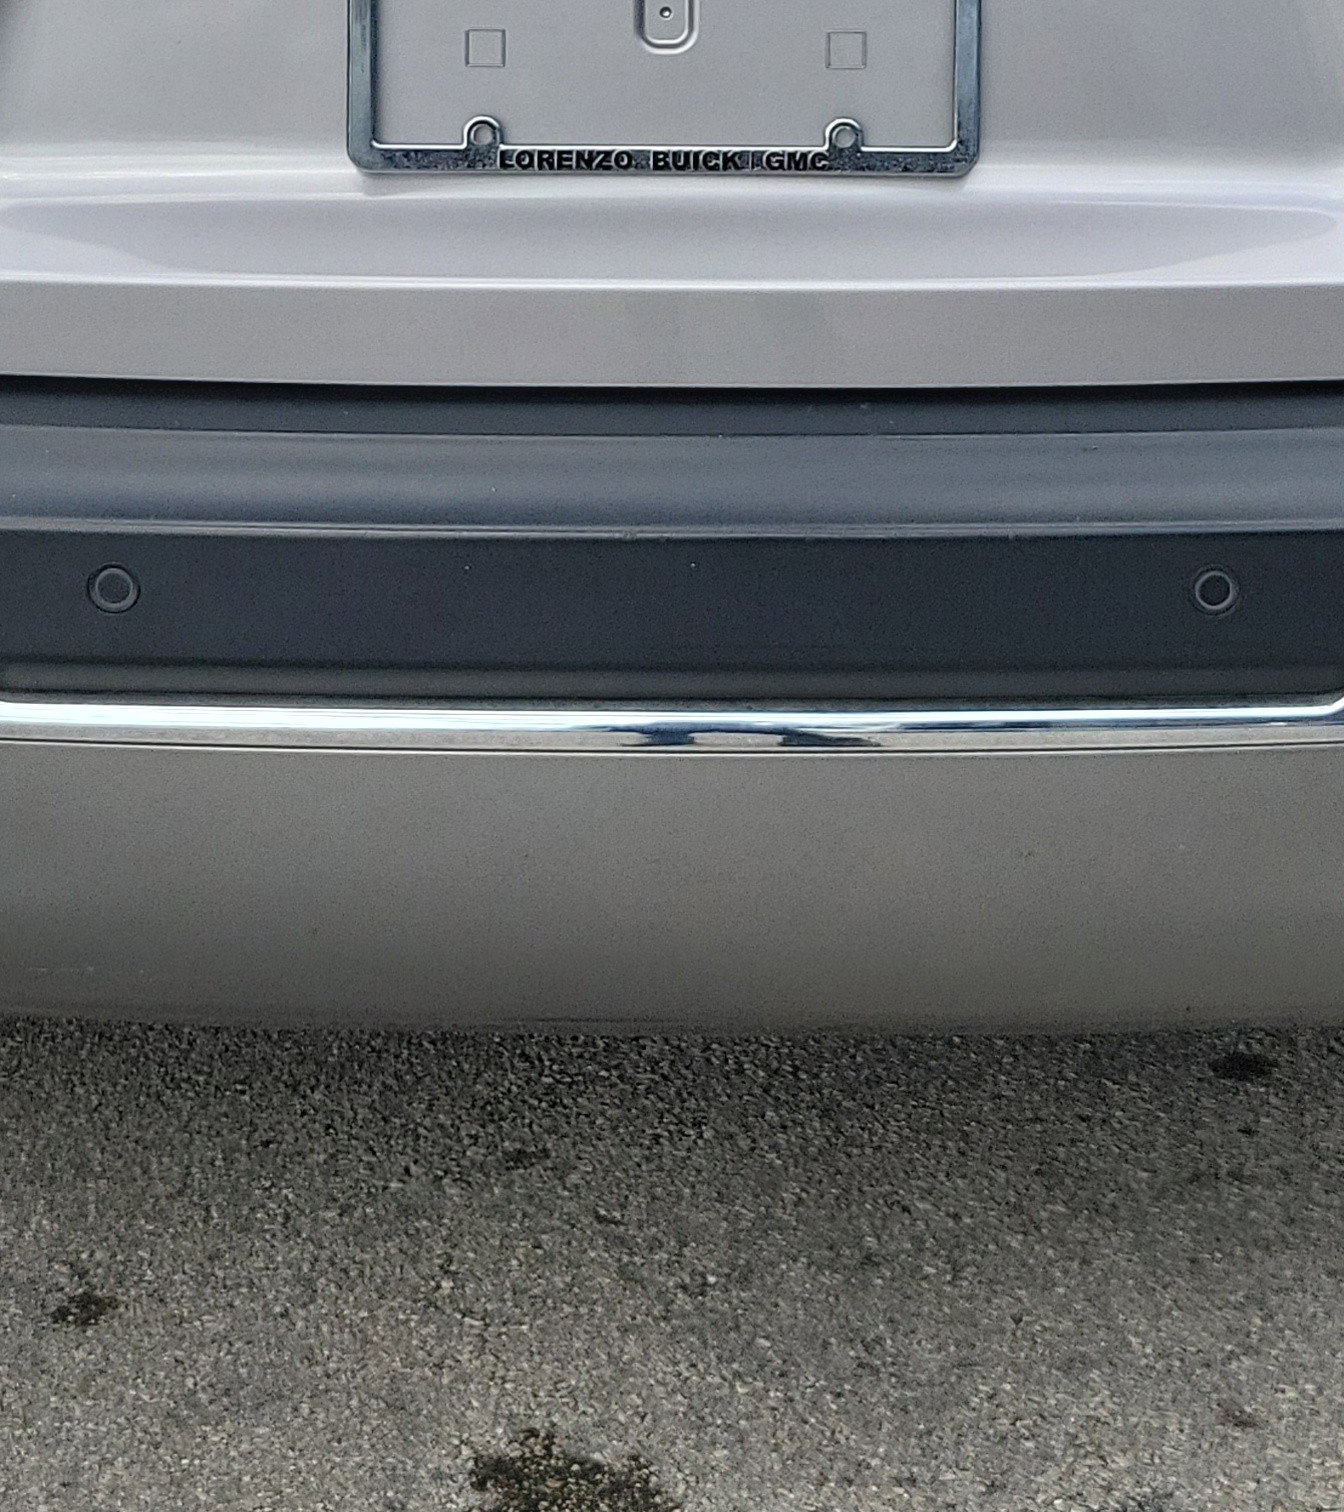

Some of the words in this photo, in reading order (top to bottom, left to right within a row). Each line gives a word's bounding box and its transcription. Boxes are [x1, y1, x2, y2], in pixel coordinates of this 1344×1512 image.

[498, 150, 633, 172] LORENZO
[652, 151, 743, 172] BUICK
[764, 152, 828, 172] GMC
